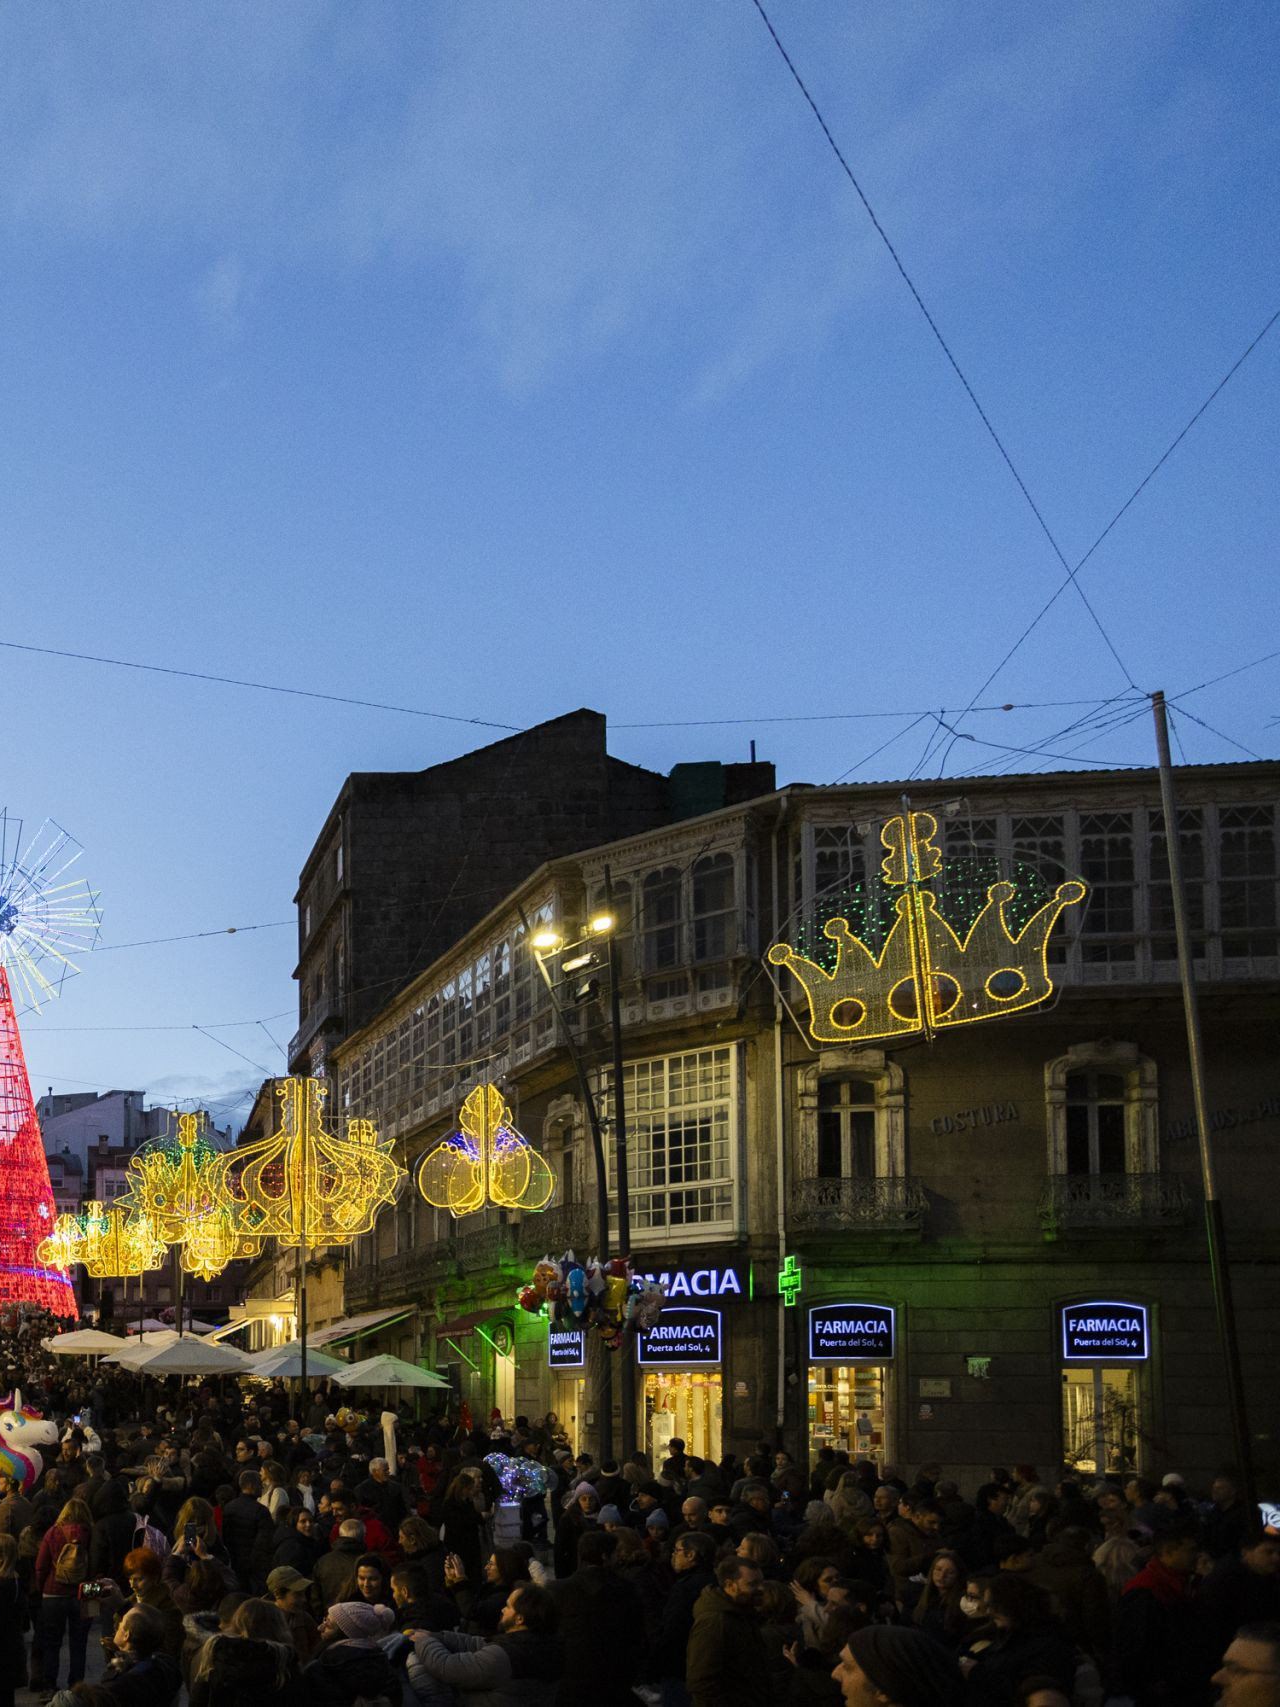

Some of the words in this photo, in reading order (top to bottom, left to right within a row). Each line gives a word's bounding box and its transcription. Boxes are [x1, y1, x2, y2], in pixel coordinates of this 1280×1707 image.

[929, 1100, 1020, 1136] COSTURA
[815, 1320, 888, 1334] FARMACIA
[1069, 1319, 1141, 1332] FARMACIA
[550, 1331, 581, 1345] FARMACIA
[642, 1325, 715, 1340] ARMACIA
[647, 1344, 673, 1352] Puerta
[674, 1343, 687, 1352] del
[688, 1343, 703, 1353] Sol,
[705, 1344, 711, 1353] 4
[820, 1338, 846, 1347] Puerta
[848, 1338, 860, 1347] del
[861, 1338, 877, 1348] Sol,
[1074, 1338, 1100, 1346] Puerta
[1102, 1338, 1114, 1346] del
[1115, 1338, 1130, 1348] Sol,
[1131, 1340, 1137, 1348] 4
